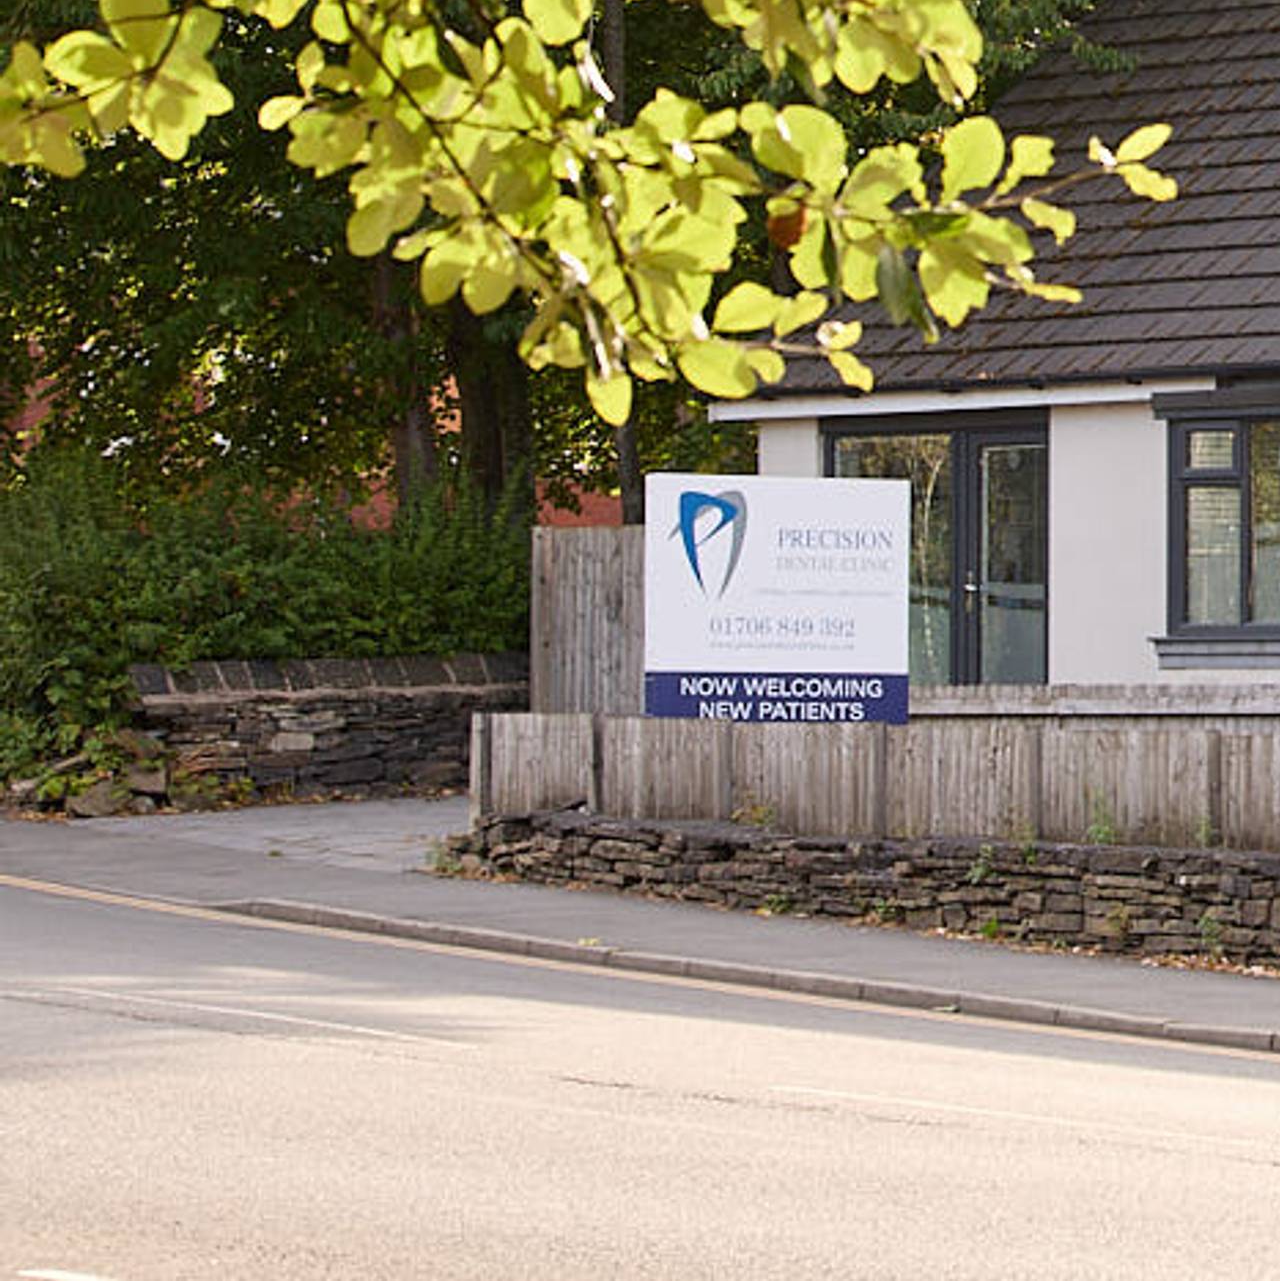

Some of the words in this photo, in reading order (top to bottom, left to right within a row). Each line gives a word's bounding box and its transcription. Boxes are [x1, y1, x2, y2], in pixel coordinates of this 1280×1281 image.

[778, 528, 893, 549] PRECISION
[777, 616, 814, 637] 849
[680, 677, 739, 696] NOW
[744, 678, 883, 698] WELCOMING
[699, 702, 752, 719] NEW
[759, 702, 865, 720] PATIENTS
